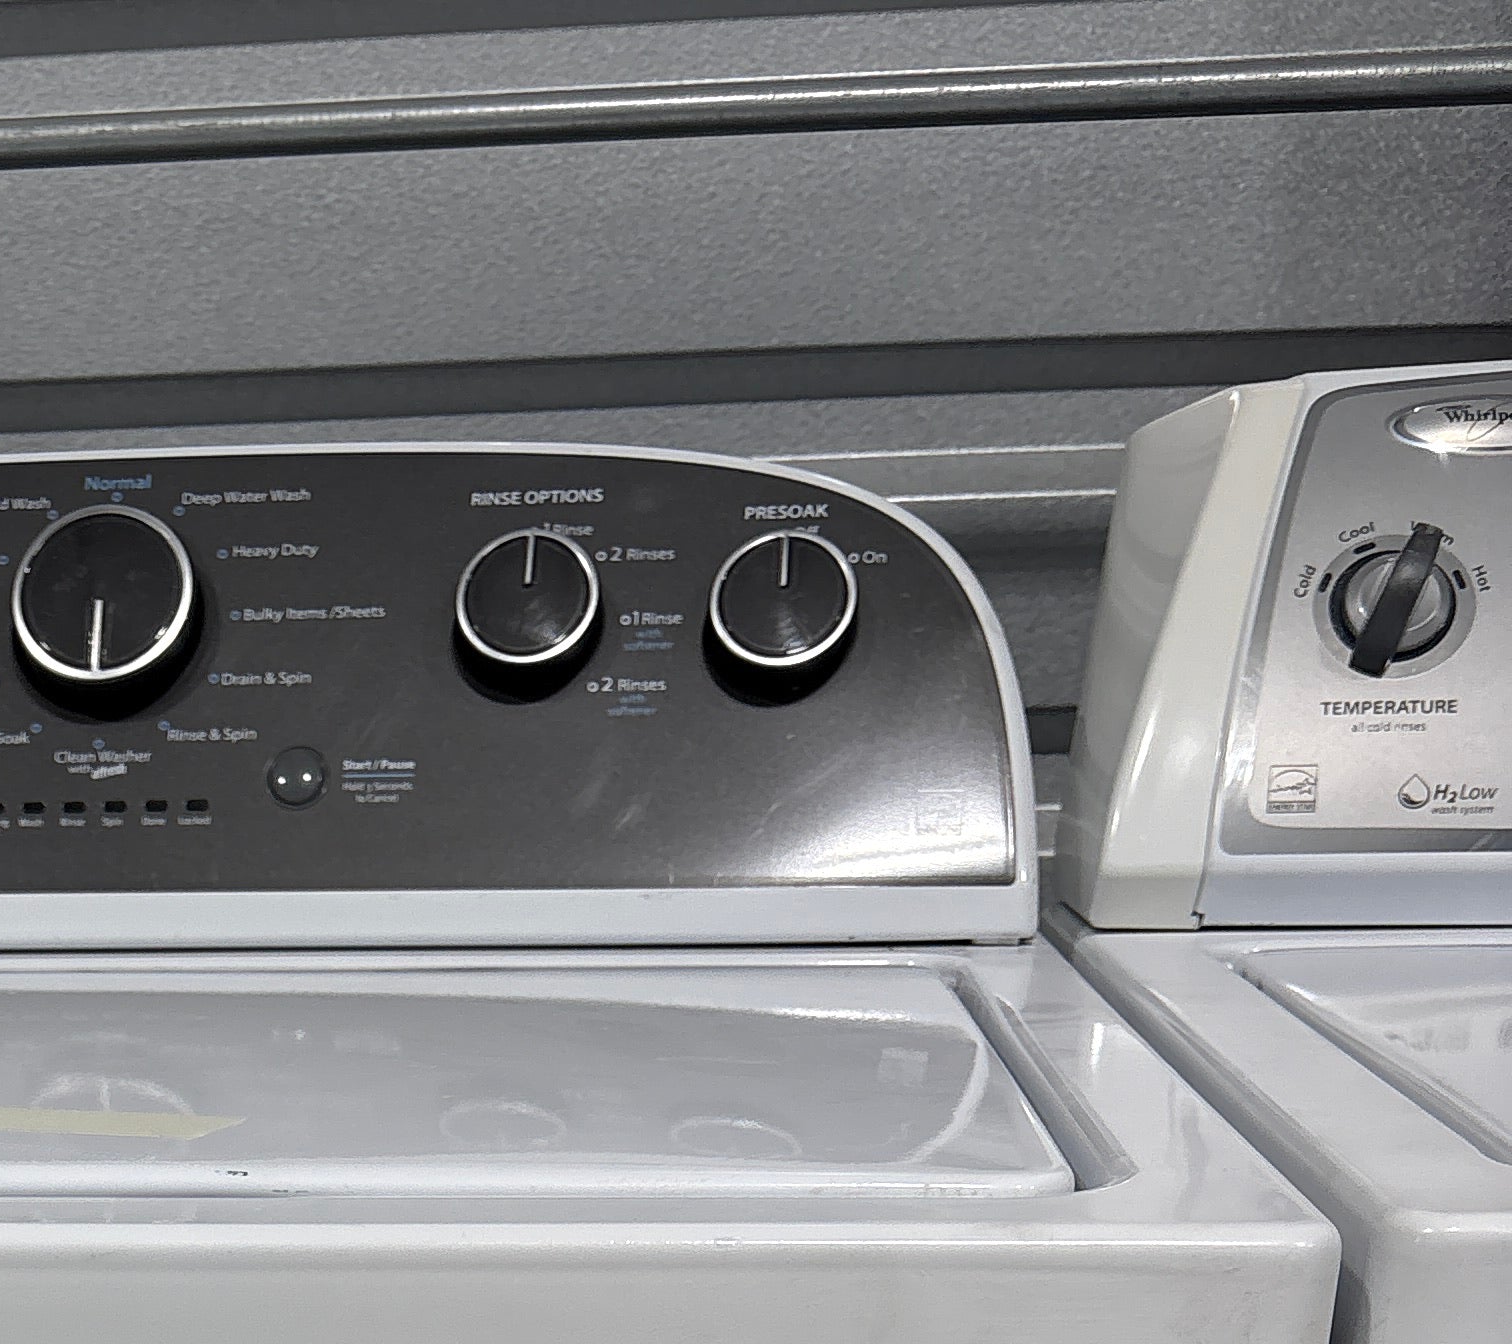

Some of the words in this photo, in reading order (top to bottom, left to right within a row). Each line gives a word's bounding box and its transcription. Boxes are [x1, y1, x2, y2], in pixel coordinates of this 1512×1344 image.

[84, 474, 152, 491] Normal
[12, 497, 51, 510] Wash
[181, 492, 222, 506] Deep
[224, 491, 267, 503] Water
[270, 488, 311, 502] Wash
[470, 490, 522, 506] RINSE
[524, 488, 605, 504] OPTIONS
[744, 503, 829, 520] PRESOAK
[1338, 521, 1376, 543] Cool
[232, 545, 280, 559] Heavy
[280, 543, 320, 558] Duty
[610, 547, 623, 562] 2
[626, 549, 677, 561] Rinses
[862, 550, 888, 564] On
[1292, 563, 1317, 599] Cold
[1470, 563, 1492, 593] Hot
[243, 608, 284, 623] Bulky
[633, 611, 640, 625] 1
[641, 612, 685, 625] Rinse
[220, 672, 262, 686] Drain
[264, 673, 276, 685] &
[278, 672, 312, 688] Spin
[601, 677, 614, 692] 2
[617, 679, 668, 691] Rinses
[1320, 699, 1459, 716] TEMPERATURE
[1366, 721, 1391, 732] cold
[1393, 722, 1427, 732] rinses
[167, 729, 208, 742] Rinse
[208, 729, 221, 741] &
[222, 728, 258, 743] Spin
[53, 751, 96, 764] Clean
[96, 750, 152, 763] Washer
[1432, 805, 1457, 814] wash
[1459, 806, 1494, 815] system
